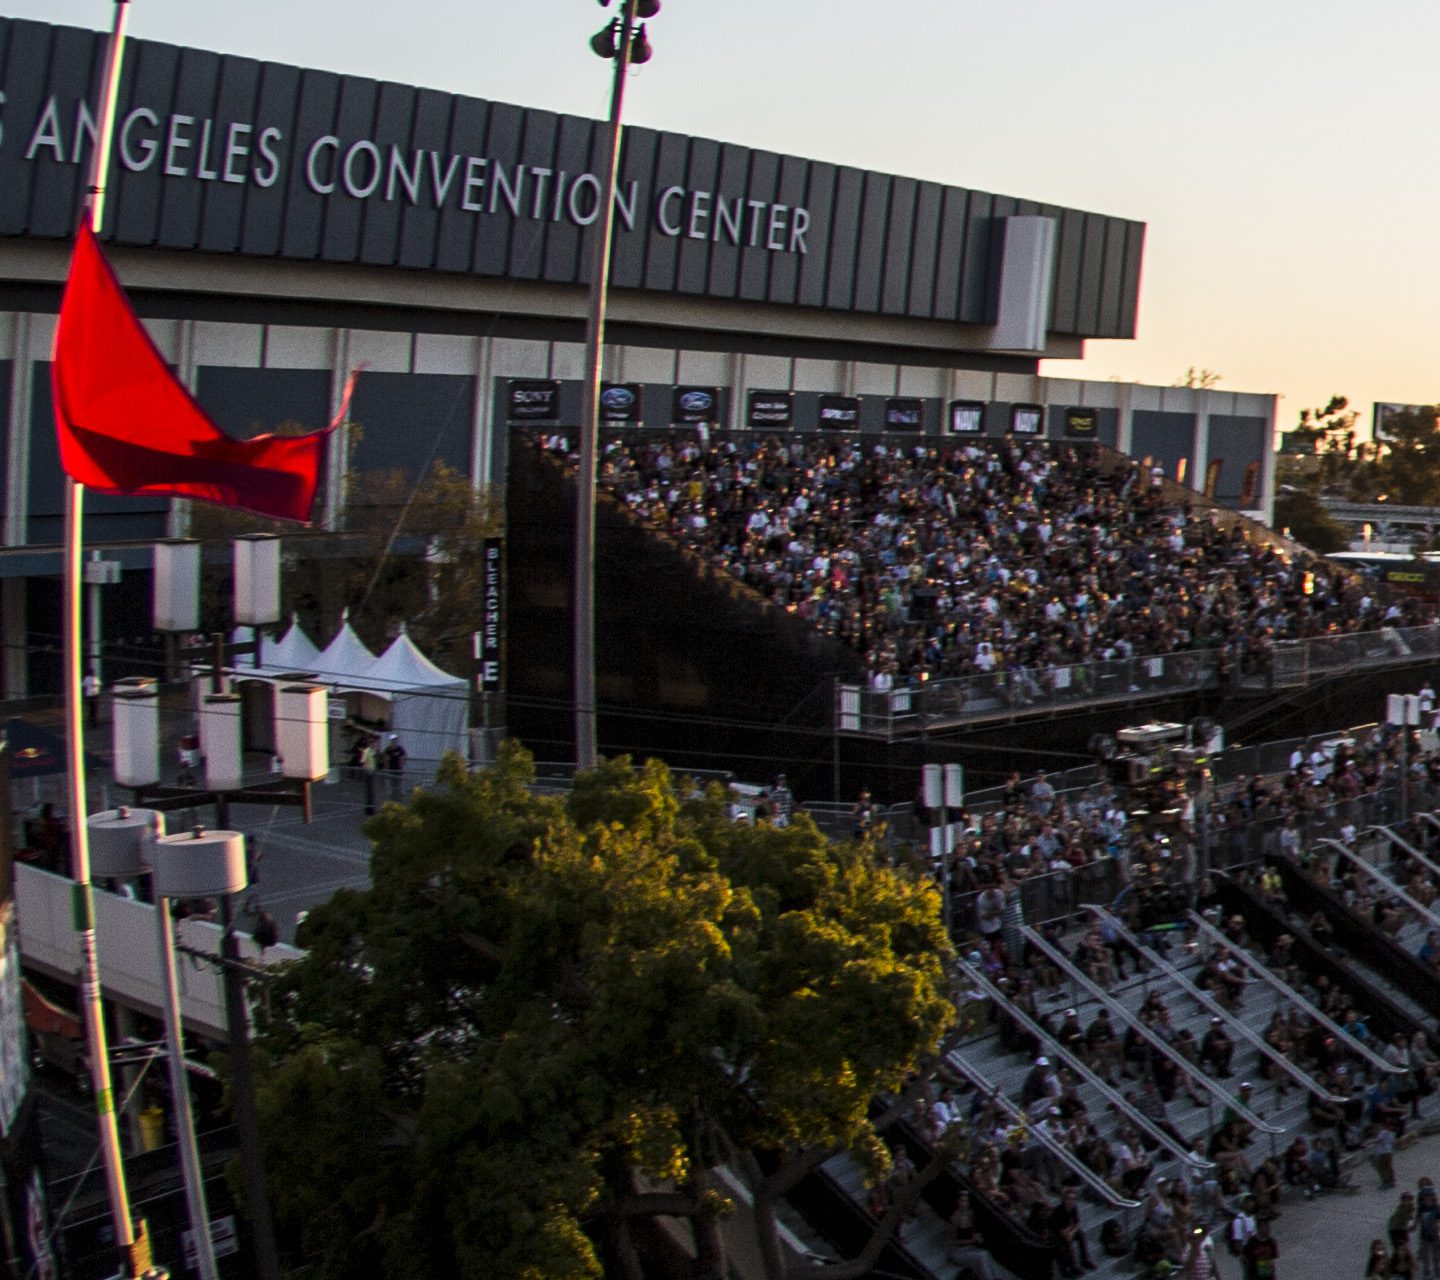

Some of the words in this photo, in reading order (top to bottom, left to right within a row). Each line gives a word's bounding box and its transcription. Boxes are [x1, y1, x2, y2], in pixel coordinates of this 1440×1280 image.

[304, 135, 640, 233] CONVENTION
[657, 184, 812, 255] CENTER
[485, 547, 500, 649] BLEACHER
